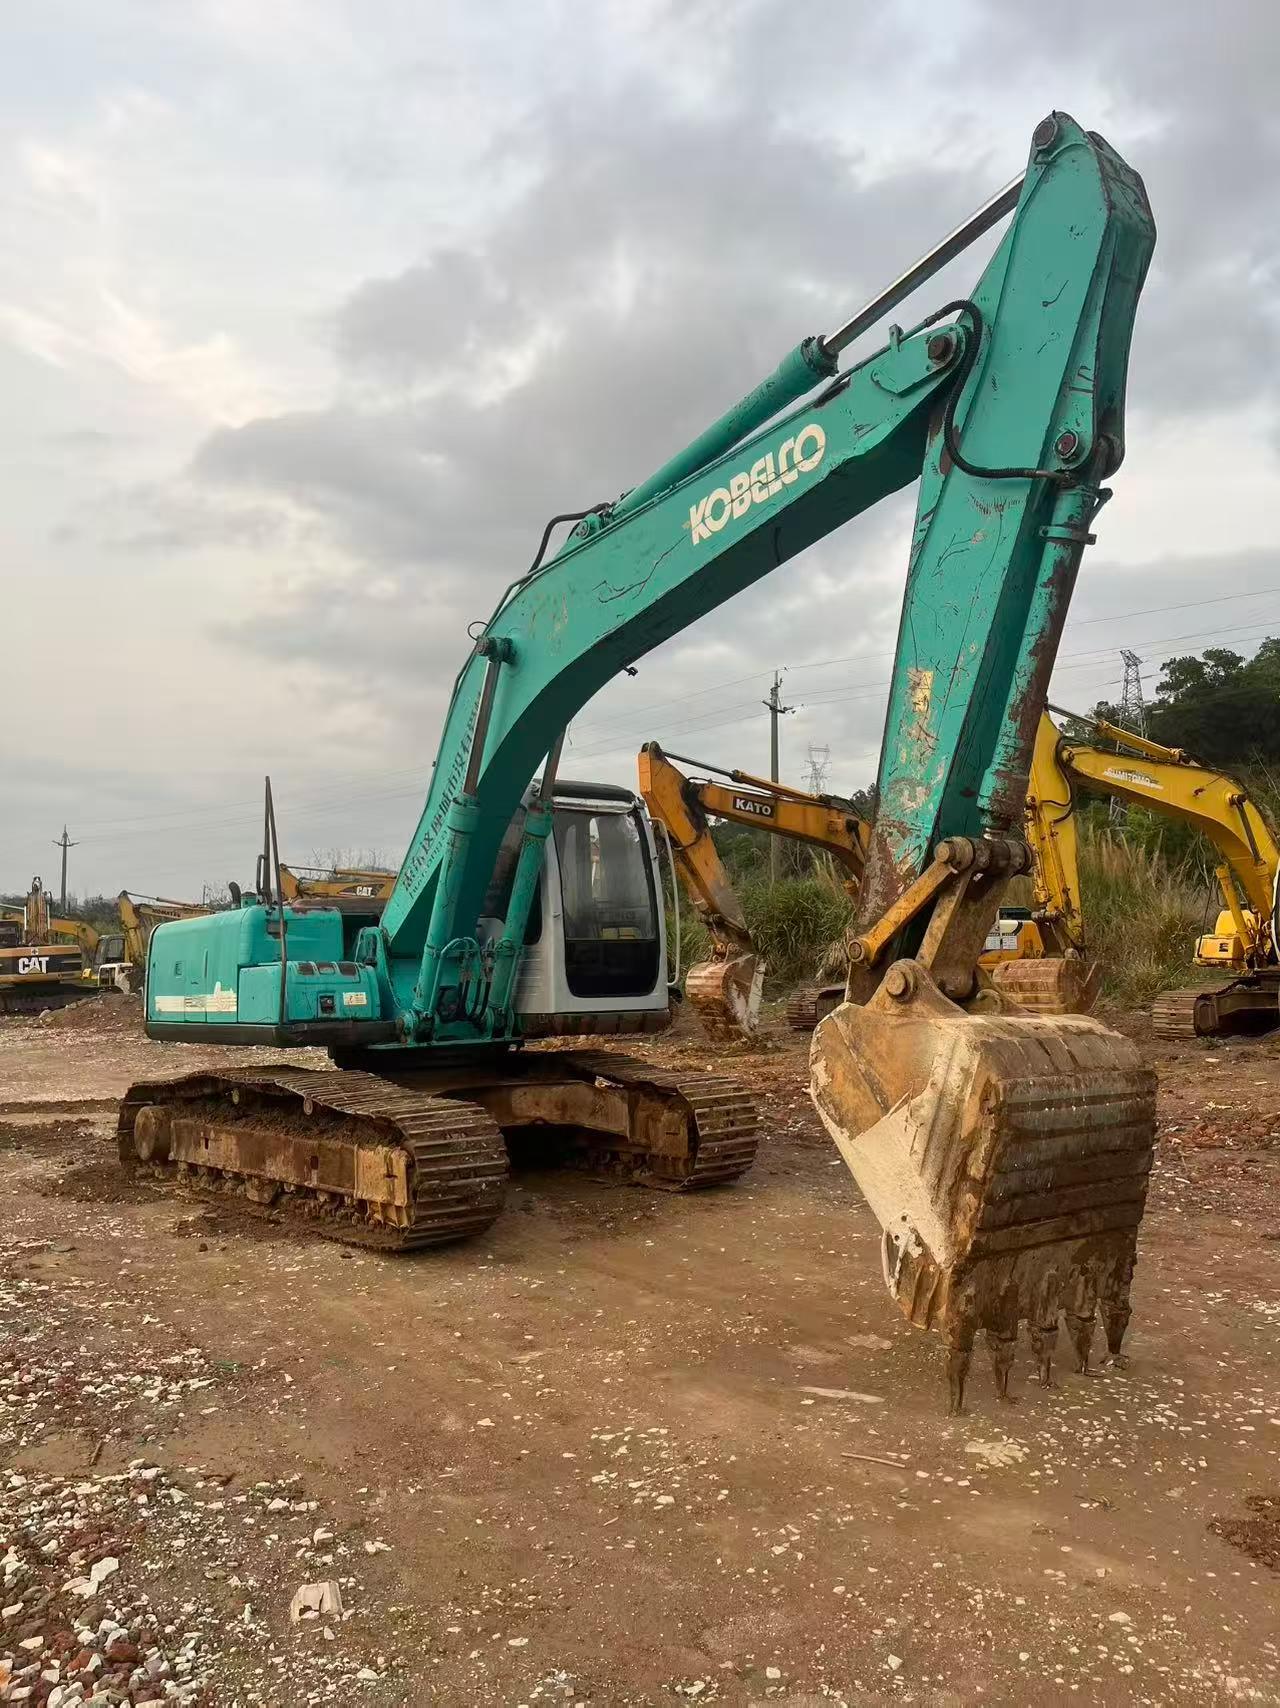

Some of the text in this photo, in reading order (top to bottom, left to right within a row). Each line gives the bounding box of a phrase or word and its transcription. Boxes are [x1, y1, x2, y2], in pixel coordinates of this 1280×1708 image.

[689, 423, 826, 545] KOBELCO
[736, 798, 771, 815] KATO
[356, 886, 373, 896] CAT
[18, 956, 50, 974] CAT
